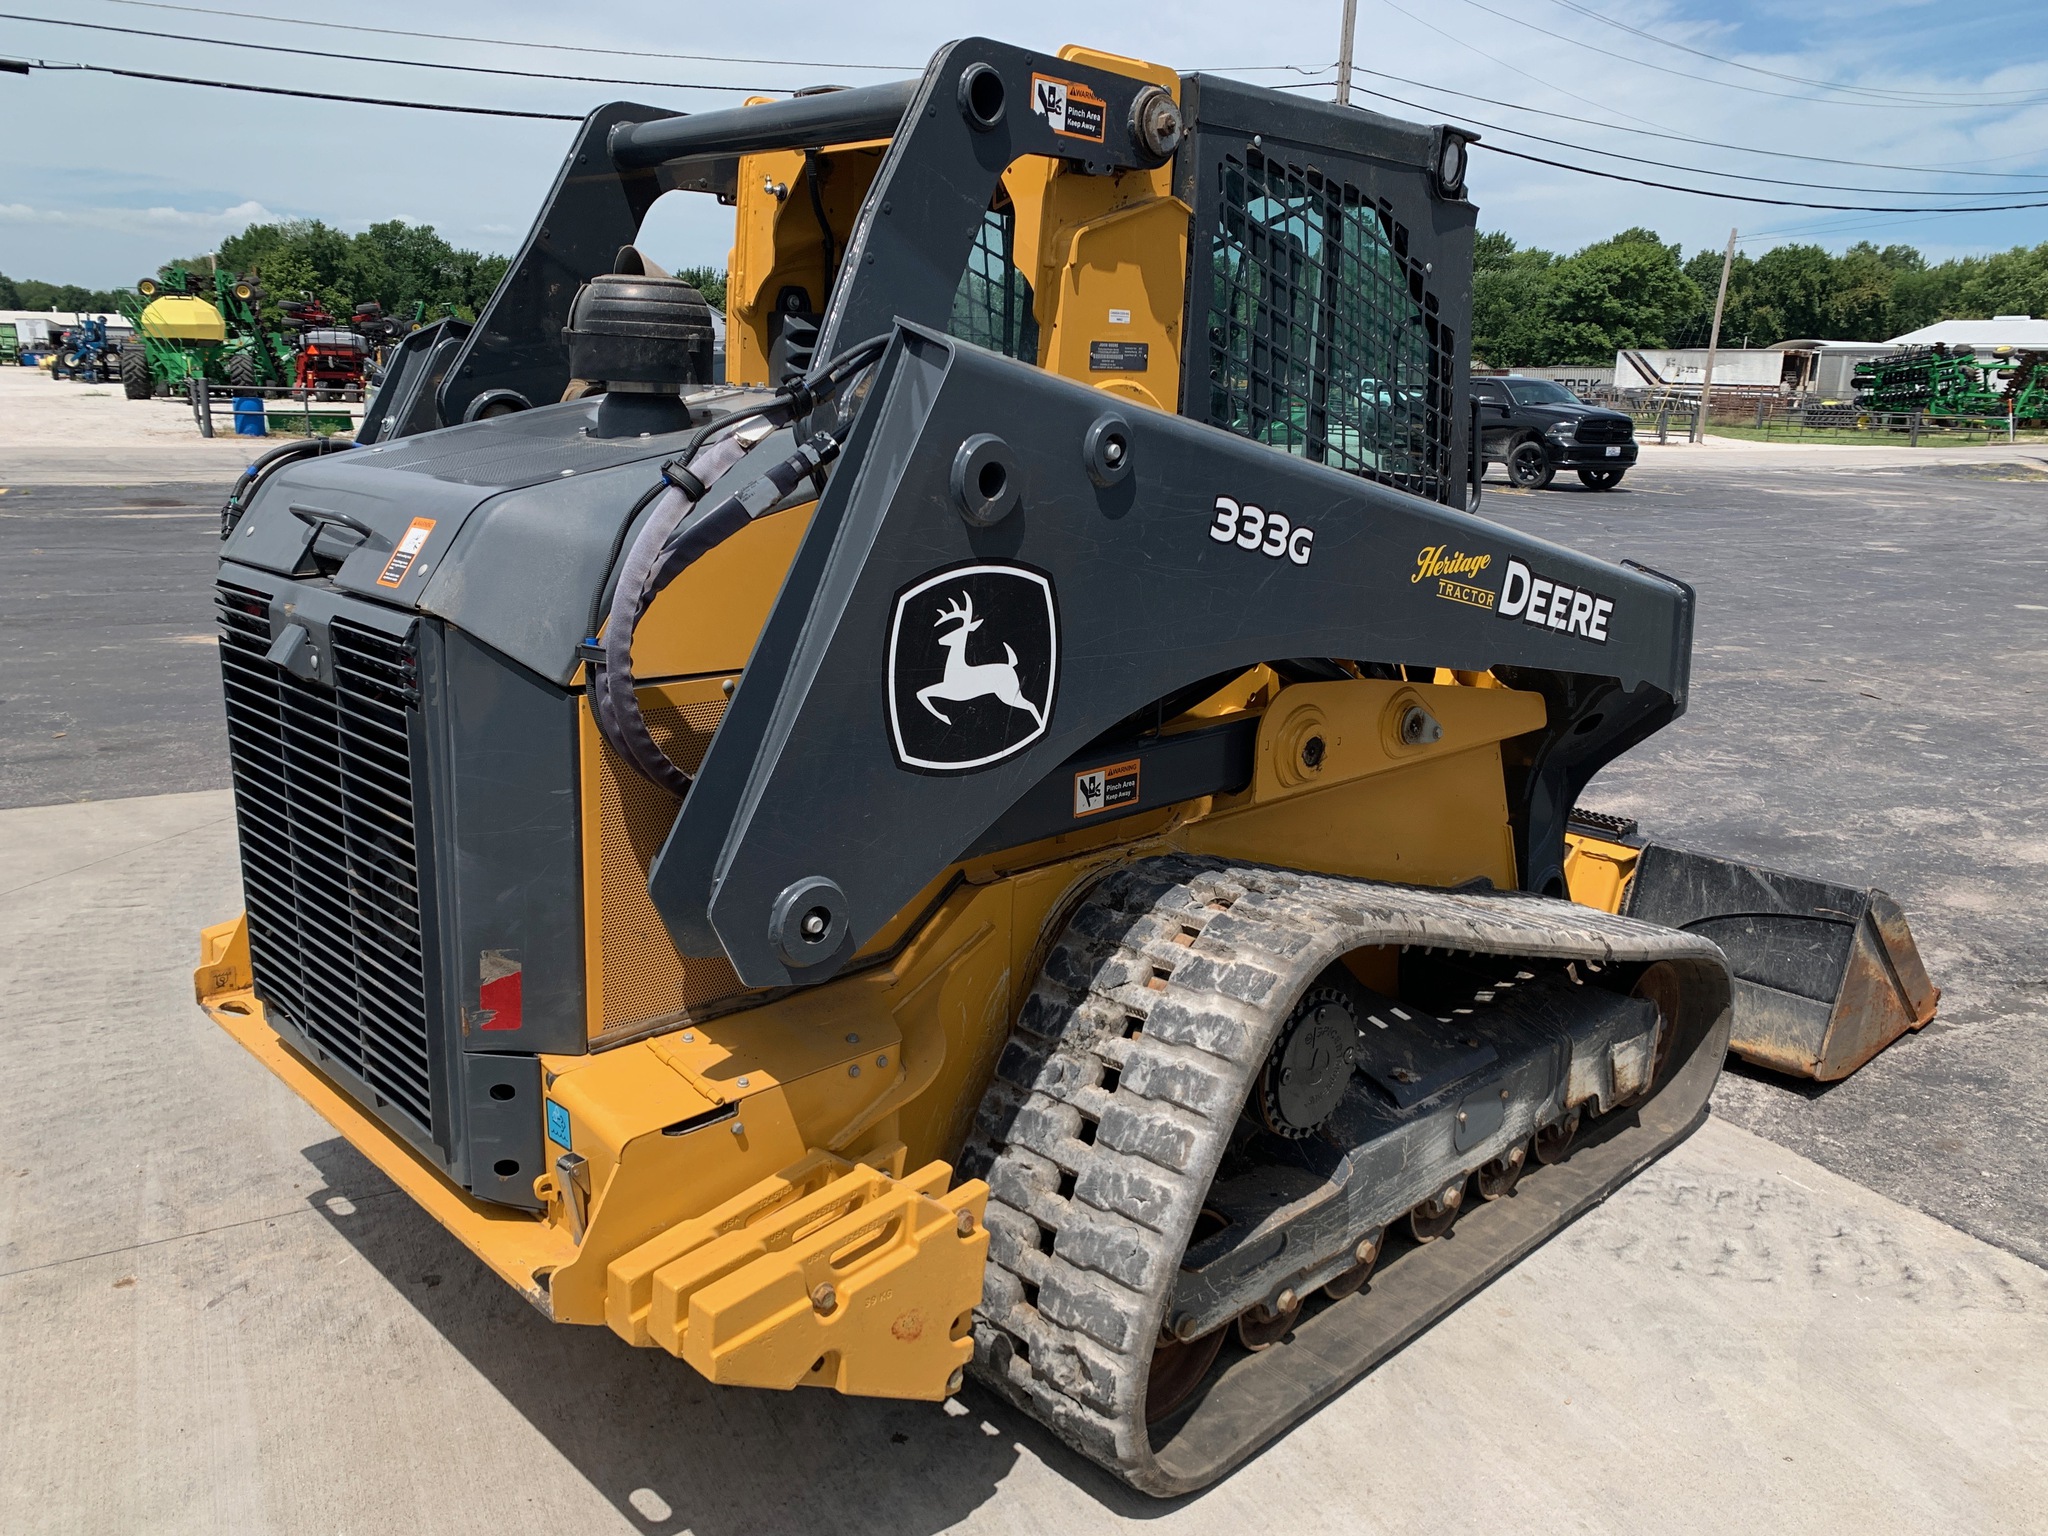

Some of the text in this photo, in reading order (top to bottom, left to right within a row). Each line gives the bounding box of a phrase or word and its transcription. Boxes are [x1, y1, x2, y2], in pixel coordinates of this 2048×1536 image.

[1068, 106, 1101, 121] Pinch Area
[1067, 117, 1096, 132] Keep Away
[1209, 497, 1314, 565] 333G
[1411, 544, 1492, 584] Heritage
[1438, 580, 1495, 607] TRACTOR
[1498, 559, 1614, 642] DEERE
[1112, 763, 1137, 774] WARNING
[1106, 780, 1135, 792] Pinch Area
[1106, 790, 1131, 801] Keep Away
[721, 1214, 740, 1230] USA
[769, 1227, 788, 1243] USA
[807, 1249, 825, 1265] USA
[865, 1295, 877, 1308] 39
